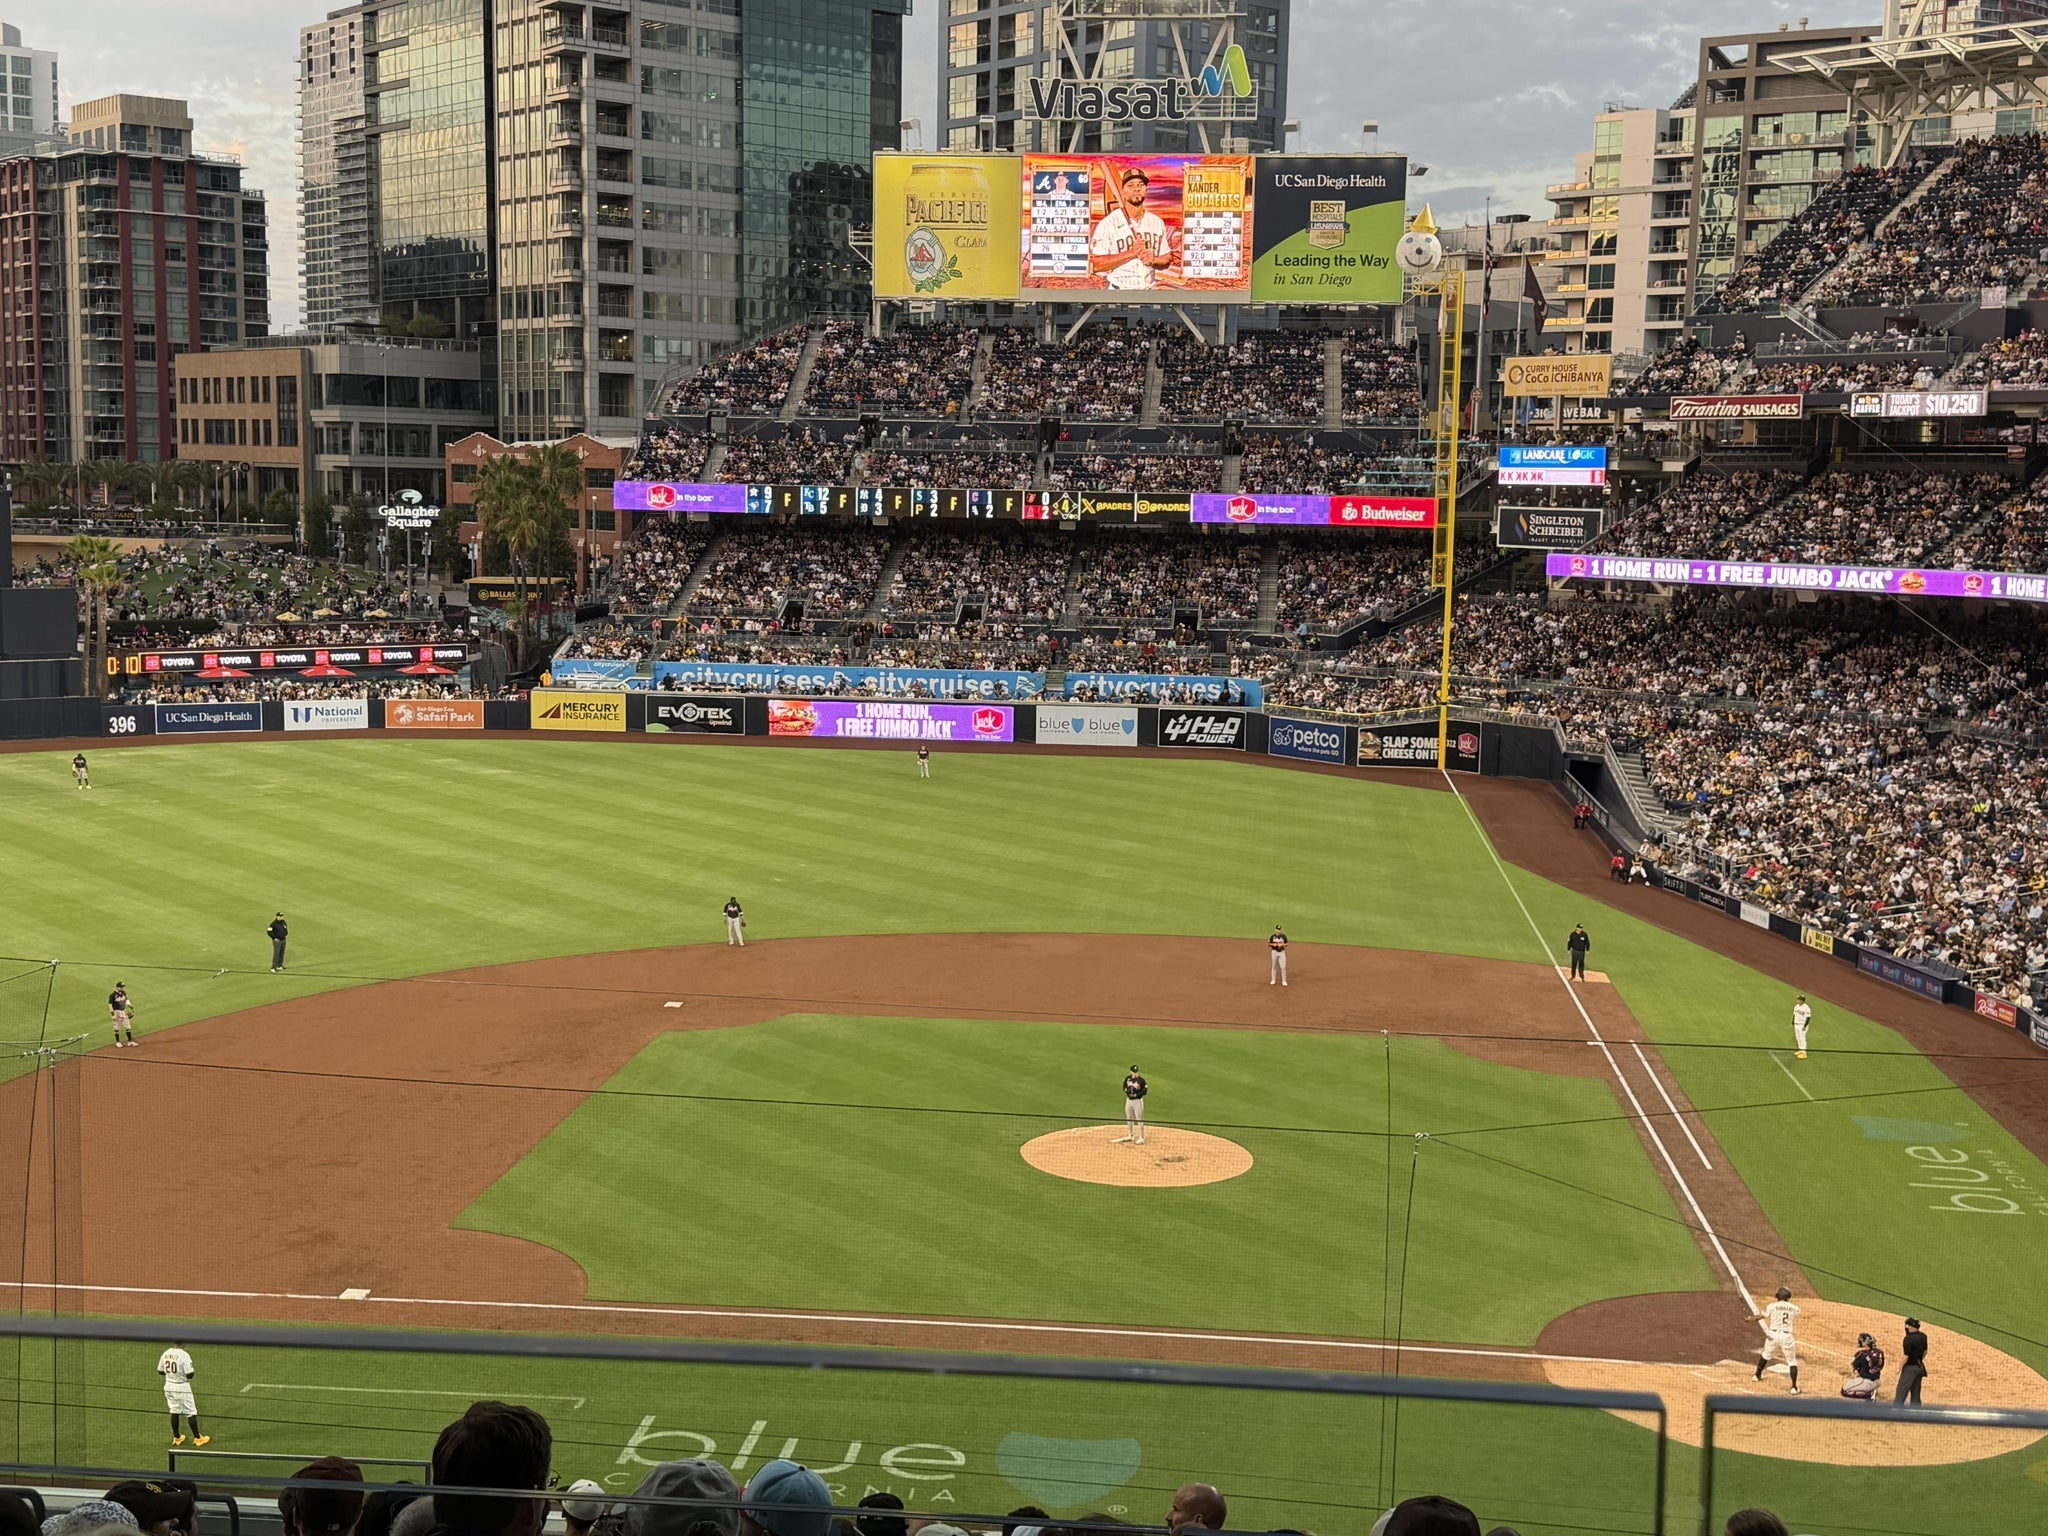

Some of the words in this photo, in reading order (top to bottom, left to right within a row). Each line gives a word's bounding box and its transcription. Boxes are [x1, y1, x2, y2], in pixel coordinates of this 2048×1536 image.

[1029, 77, 1185, 120] Viasat
[1188, 183, 1219, 193] XANDER
[1275, 174, 1294, 187] UC
[1294, 174, 1315, 187] San
[1317, 174, 1348, 189] Diego
[1350, 174, 1386, 187] Health
[1187, 194, 1240, 206] BOGAERTS
[906, 194, 988, 226] PACIFICO
[1313, 202, 1343, 213] BEST
[1312, 213, 1343, 221] HOSPITALS
[1275, 254, 1330, 268] Leading
[1334, 254, 1356, 266] the
[1360, 254, 1389, 269] Way
[1274, 273, 1286, 285] in
[1290, 273, 1313, 285] San
[1318, 273, 1352, 287] Diego
[1526, 365, 1550, 373] CURRY
[1552, 364, 1578, 372] HOUSE
[1525, 374, 1549, 383] CoCo
[1551, 372, 1604, 383] ICHIBANYA
[1891, 394, 1920, 405] TODAY'S
[1925, 394, 1978, 415] $10,250
[1580, 407, 1601, 418] BAR
[1673, 400, 1741, 416] Tarantino
[1742, 403, 1798, 416] SAUSAGES
[1889, 405, 1920, 415] JACKPOT
[1523, 450, 1565, 460] LANDCARE
[684, 493, 696, 501] the
[764, 486, 772, 499] 9
[818, 487, 829, 501] 12
[875, 488, 883, 501] 4
[930, 490, 938, 502] 3
[987, 490, 993, 504] 1
[1041, 492, 1049, 505] 0
[764, 500, 772, 513] 7
[784, 493, 791, 507] F
[839, 494, 847, 508] F
[895, 495, 902, 509] F
[951, 496, 958, 511] F
[1006, 497, 1013, 511] F
[1062, 499, 1069, 513] 4
[378, 505, 441, 519] Gallagher
[819, 501, 828, 514] 5
[874, 502, 882, 515] 3
[915, 504, 923, 515] P
[930, 503, 938, 517] 2
[986, 505, 994, 518] 2
[1041, 506, 1049, 519] 2
[1096, 502, 1133, 512] @PADRES
[1150, 502, 1190, 512] @PADRES
[1361, 504, 1426, 521] Budweiser
[387, 516, 432, 529] Square
[1529, 513, 1584, 526] SINGLETON
[1529, 525, 1584, 537] SCHREIBER
[1591, 559, 1600, 575] 1
[1603, 560, 1651, 578] HOME
[1654, 562, 1690, 580] RUN
[1707, 564, 1717, 581] 1
[1720, 566, 1764, 584] FREE
[1766, 567, 1832, 587] JUMBO
[1991, 577, 2002, 594] 1
[2006, 577, 2045, 598] HOME
[219, 655, 252, 665] TOYOTA
[275, 654, 306, 663] TOYOTA
[330, 653, 361, 662] TOYOTA
[383, 651, 413, 660] TOYOTA
[434, 649, 463, 659] TOYOTA
[161, 657, 195, 667] TOYOTA
[315, 706, 363, 717] National
[562, 702, 620, 713] MERCURY
[658, 703, 732, 722] EVOTEK
[856, 703, 862, 718] 1
[863, 703, 900, 719] HOME
[901, 704, 932, 721] RUN,
[165, 713, 181, 723] UC
[181, 712, 199, 723] San
[199, 712, 224, 724] Diego
[224, 711, 253, 722] Health
[416, 711, 448, 722] Safari
[450, 712, 475, 723] Park
[562, 712, 620, 721] INSURANCE
[974, 711, 1003, 731] Jack
[109, 715, 137, 734] 396
[836, 718, 844, 735] 1
[845, 718, 874, 736] FREE
[875, 719, 918, 738] JUMBO
[1039, 717, 1070, 730] blue
[1089, 718, 1120, 731] blue
[1186, 733, 1236, 744] POWER
[1293, 728, 1340, 749] petco
[1382, 736, 1408, 748] SLAP
[1410, 736, 1440, 748] SOME
[1382, 748, 1414, 760] CHEESE
[1415, 749, 1430, 760] ON
[1862, 955, 1874, 969] blue
[1883, 963, 1895, 976] blue
[1904, 971, 1916, 984] blue
[1926, 979, 1939, 992] blue
[1905, 1145, 2026, 1215] blue
[1782, 1312, 1789, 1324] 2
[165, 1360, 177, 1374] 20
[615, 1415, 966, 1481] blue
